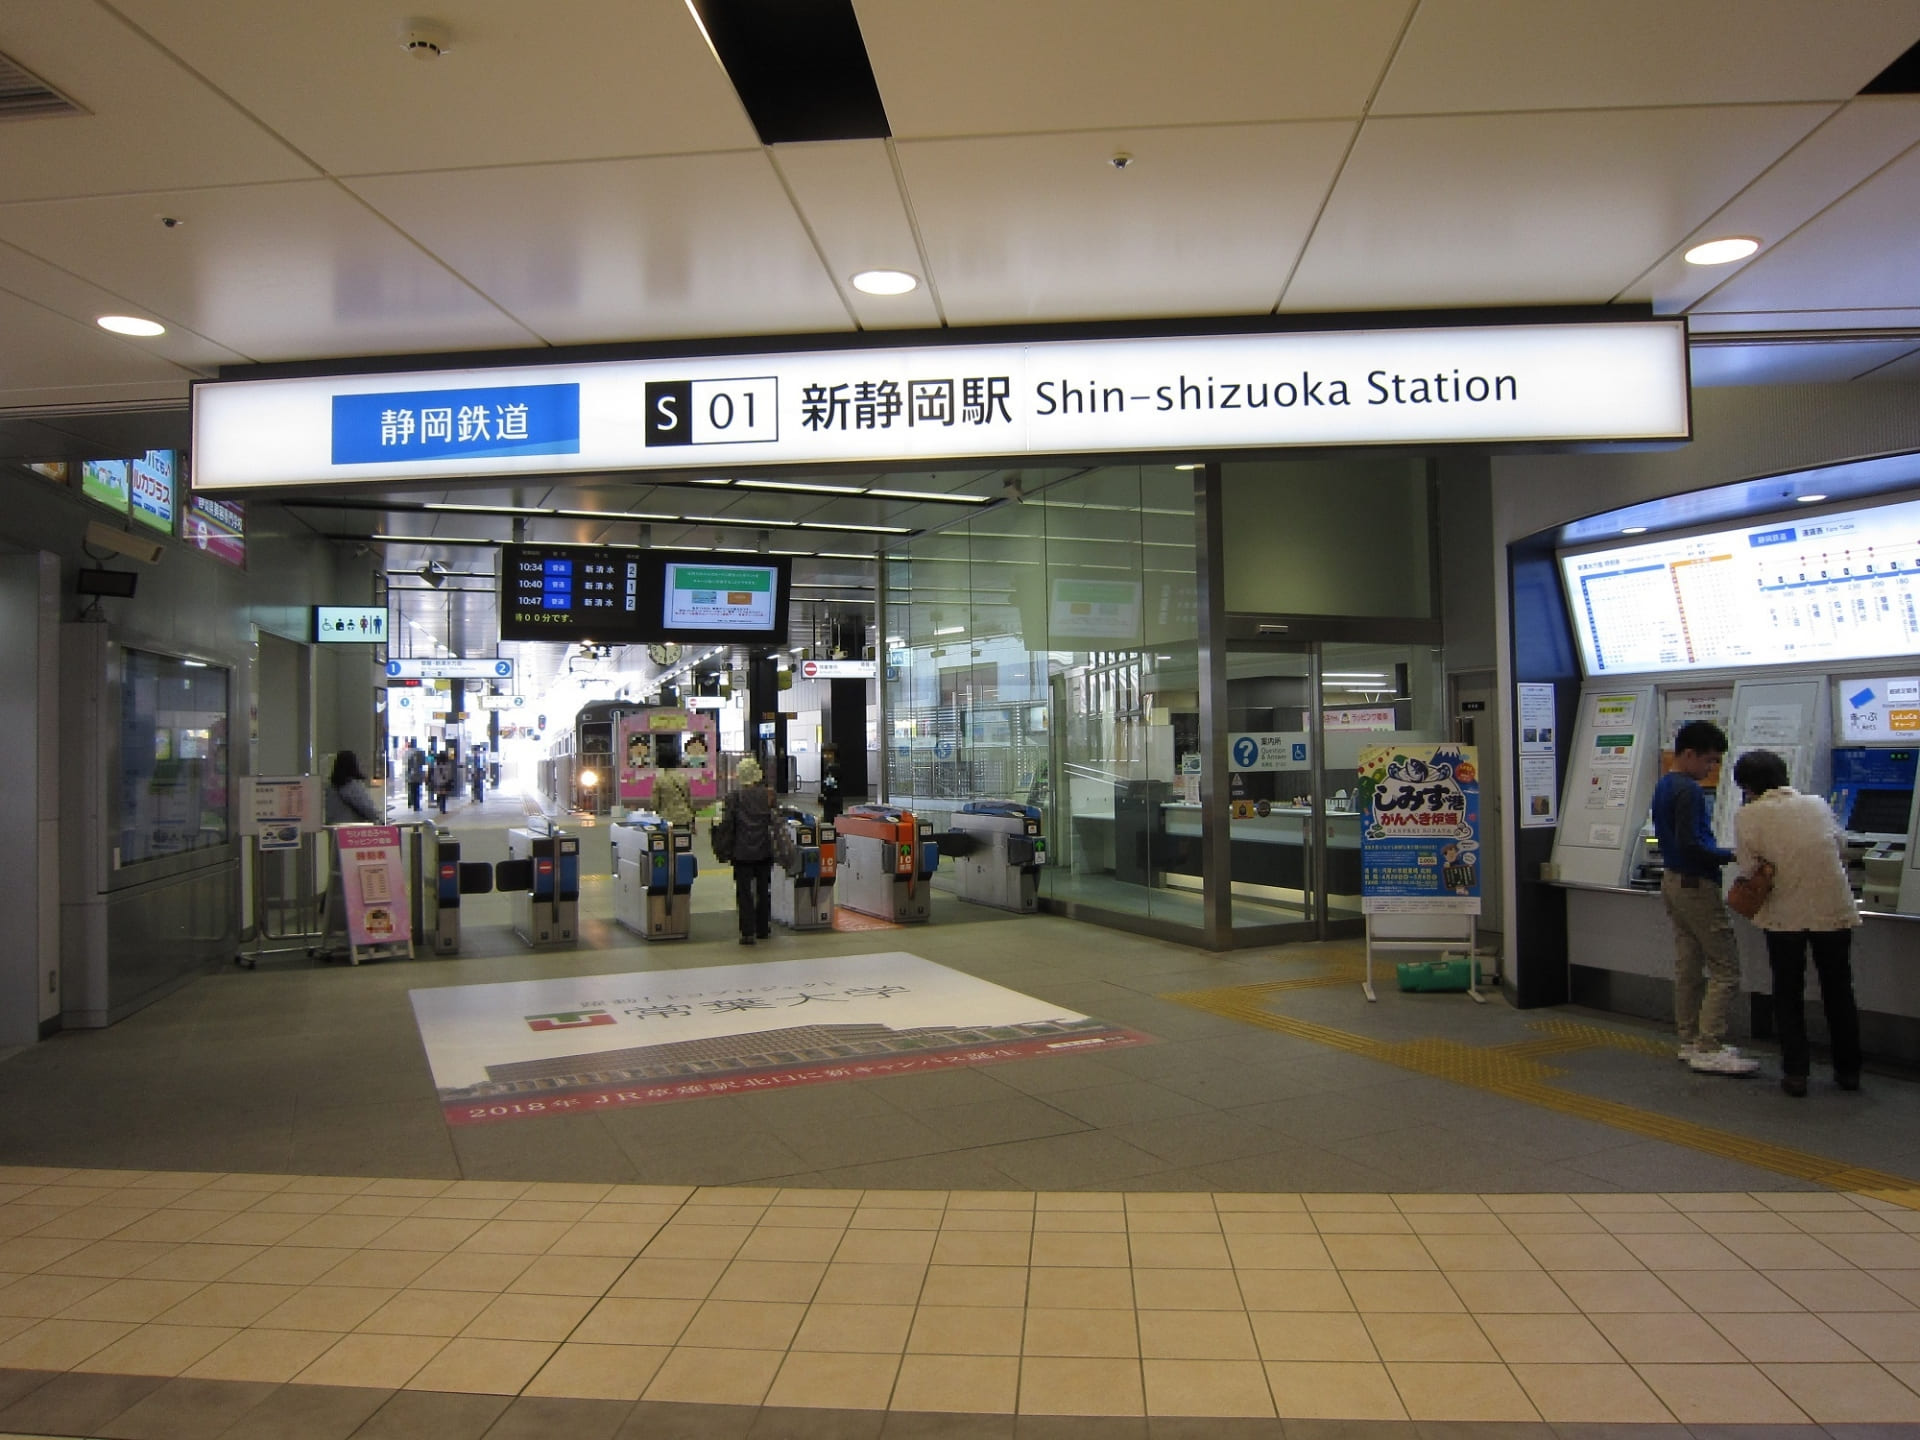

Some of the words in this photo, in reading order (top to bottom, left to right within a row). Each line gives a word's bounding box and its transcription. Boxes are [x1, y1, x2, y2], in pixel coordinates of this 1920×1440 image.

[801, 375, 1013, 432] 新静岡駅
[1035, 370, 1351, 416] Shin-shizuoka
[1367, 367, 1519, 406] Station
[380, 402, 530, 446] 静岡鉄道
[656, 395, 680, 432] S
[708, 391, 757, 431] 01
[519, 562, 543, 572] 10:34
[518, 579, 543, 588] 10:40
[517, 596, 543, 606] 10:47
[1260, 737, 1282, 746] 案内所
[623, 984, 912, 1020] 常葉大学
[469, 1098, 581, 1119] 2018年
